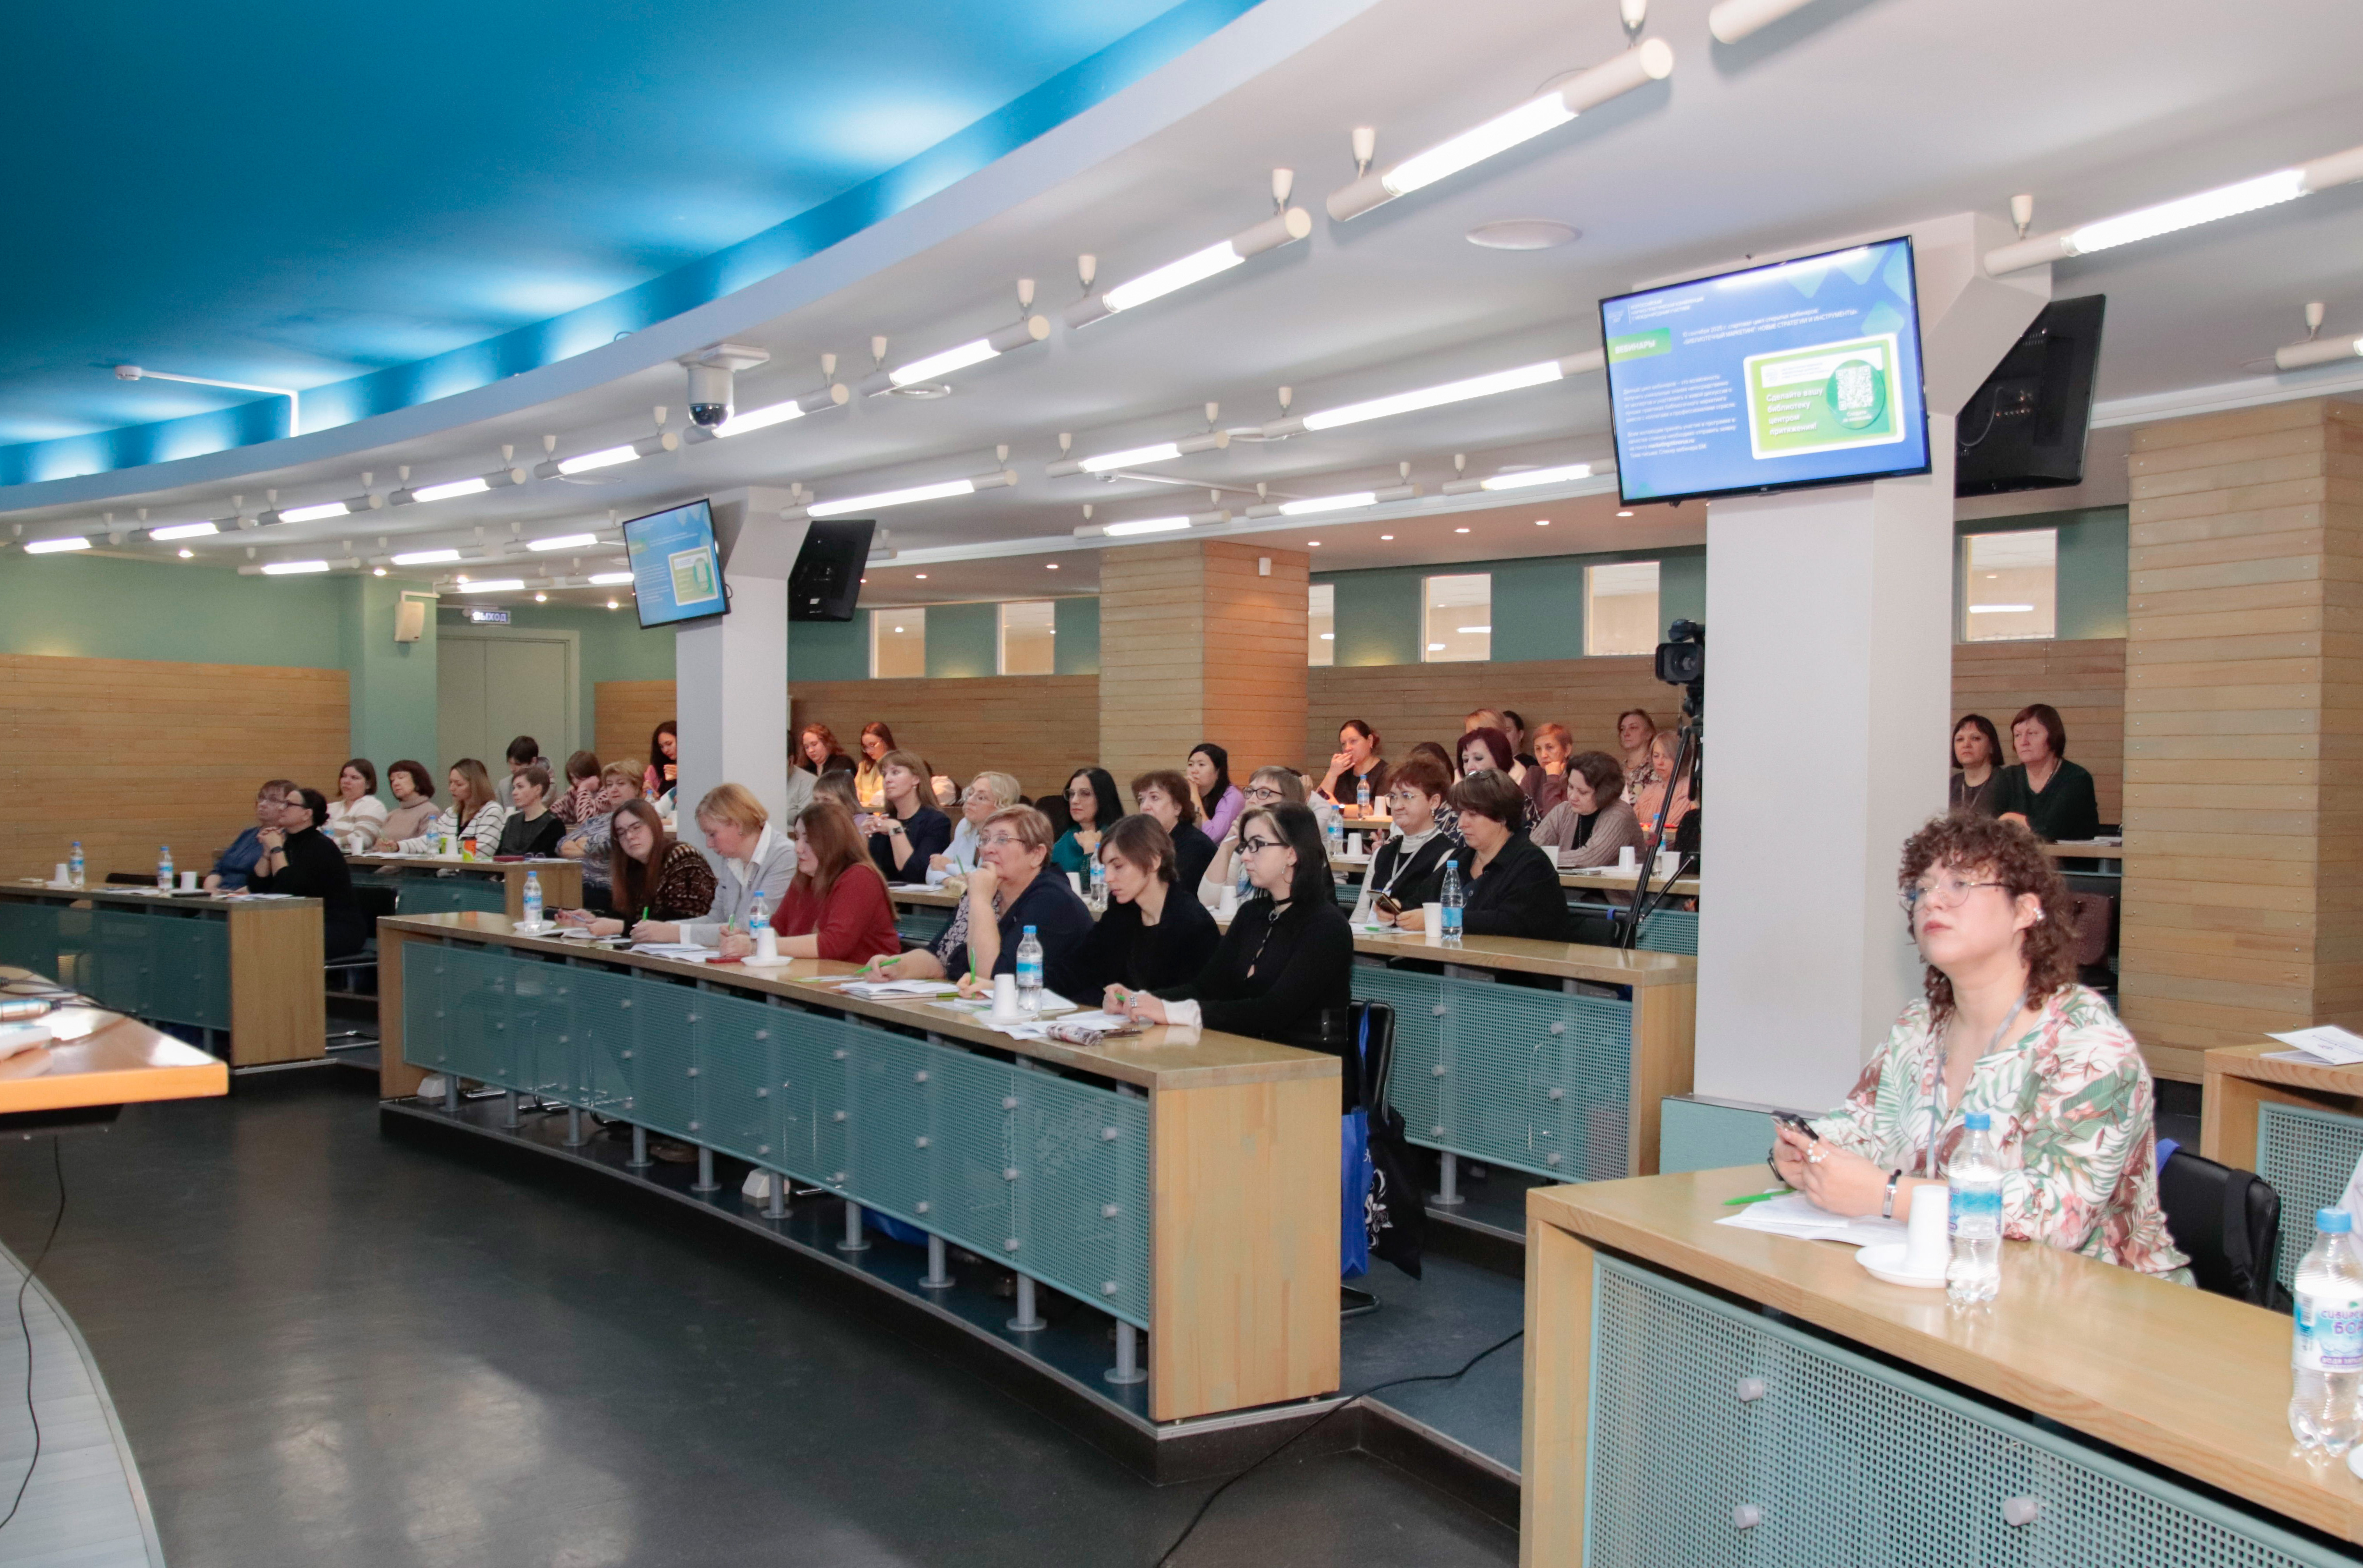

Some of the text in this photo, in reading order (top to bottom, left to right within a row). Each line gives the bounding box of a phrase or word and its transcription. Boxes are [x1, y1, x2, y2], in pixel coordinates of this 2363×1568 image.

[1777, 318, 1808, 328] СТРАТЕГИИ
[1615, 340, 1656, 354] ВЕБИНАРЫ
[1766, 387, 1824, 402] Сделайте вашу
[1767, 401, 1811, 413] библиотеку
[1769, 415, 1801, 424] центром
[1770, 422, 1817, 435] притяжения!
